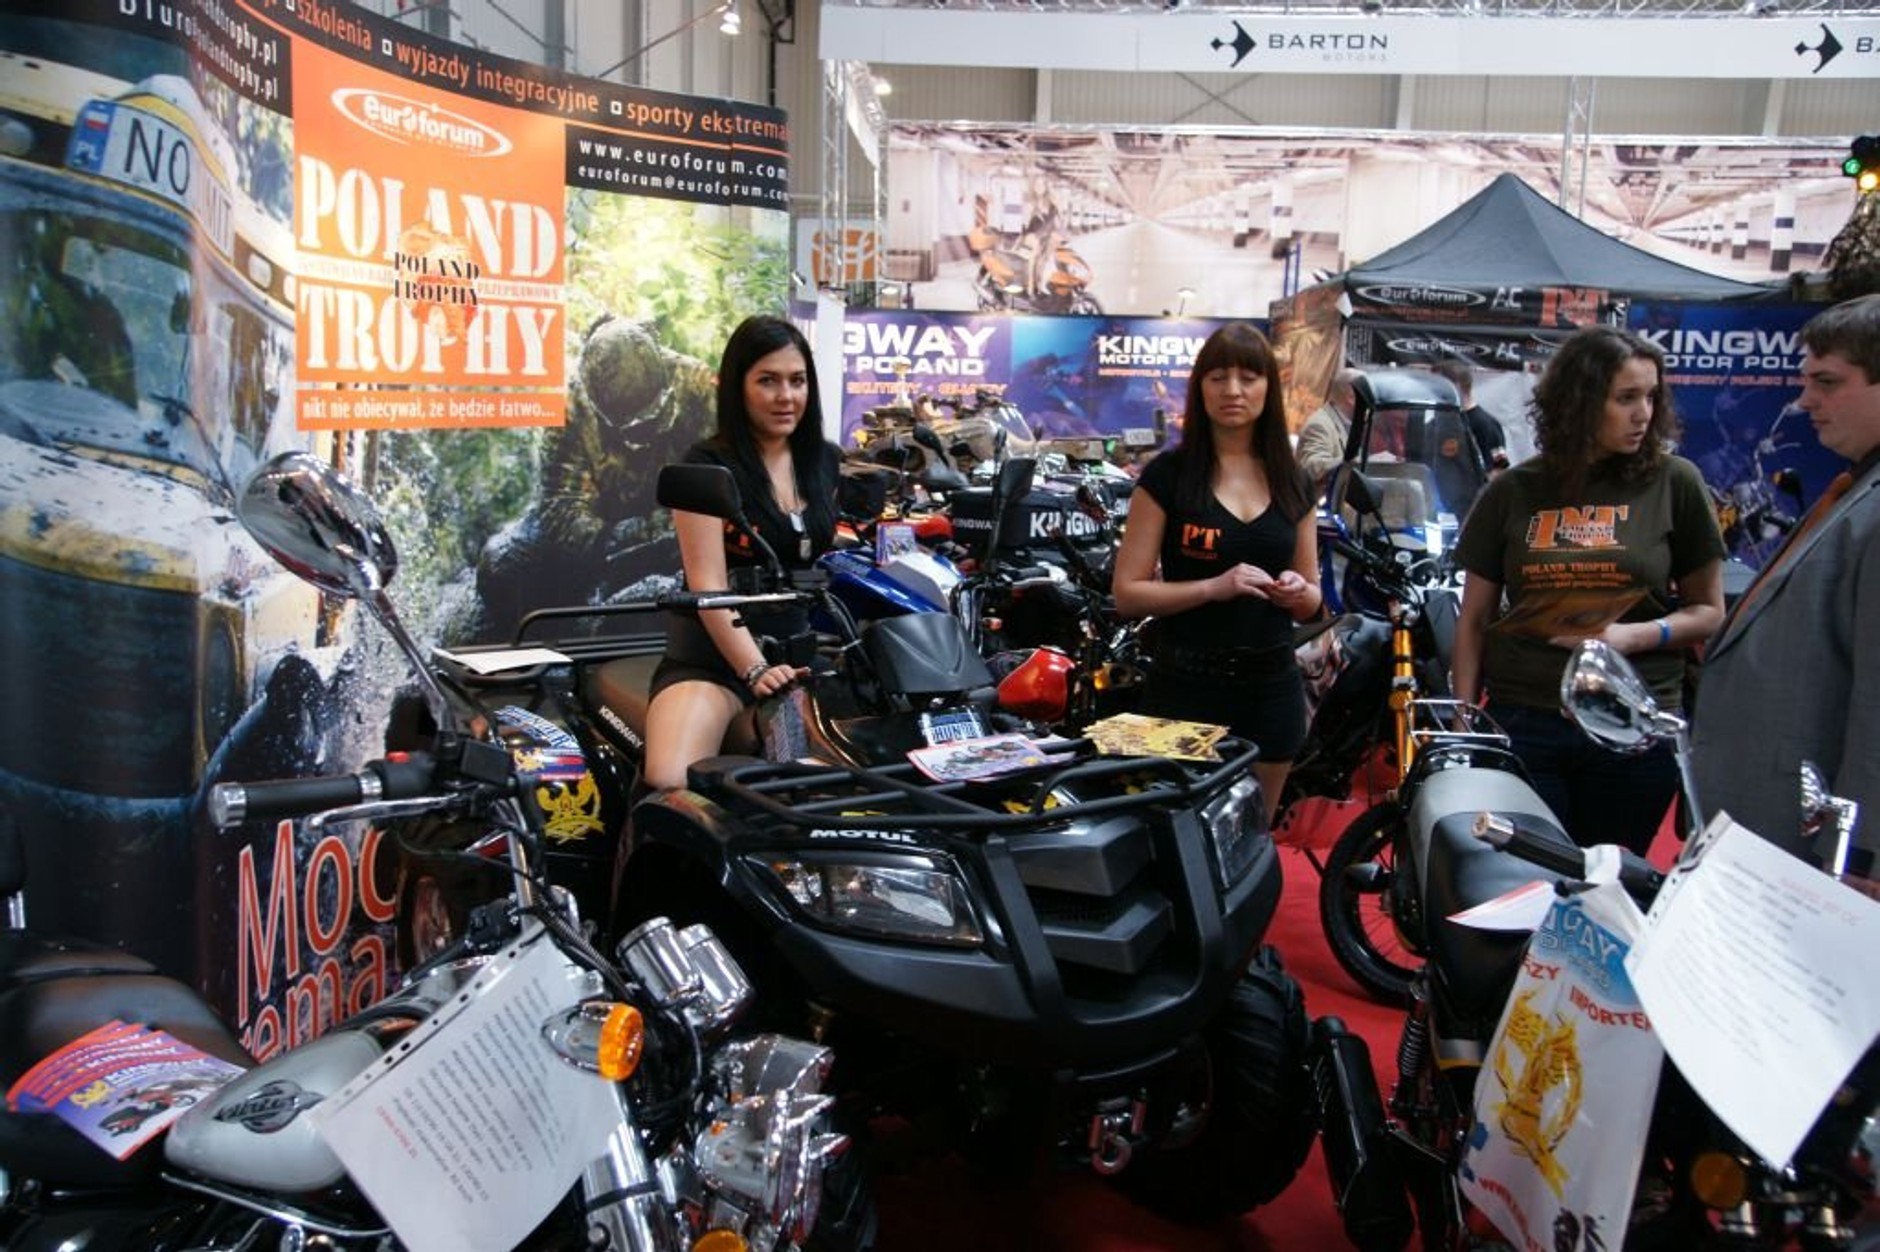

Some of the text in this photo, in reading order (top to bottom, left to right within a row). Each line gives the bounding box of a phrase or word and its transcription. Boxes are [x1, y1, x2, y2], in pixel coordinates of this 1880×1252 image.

[1268, 34, 1388, 49] BARTON
[1856, 37, 1880, 52] B
[297, 0, 792, 142] szkolenia wyjazdy integracyjne sporty ekstrema
[1322, 54, 1387, 62] MOTORS
[124, 117, 190, 196] NO
[299, 154, 557, 278] POLAND
[394, 251, 479, 281] POLAND
[394, 279, 478, 306] TROPHY
[300, 283, 557, 376] TROPHY
[1638, 329, 1808, 355] KINGW
[1099, 354, 1171, 365] MOTOR
[1663, 354, 1734, 369] OTOR
[303, 399, 326, 419] nikt
[331, 399, 350, 419] nie
[450, 399, 496, 422] będzie
[1182, 523, 1222, 550] PT
[809, 829, 918, 844] MOTUL
